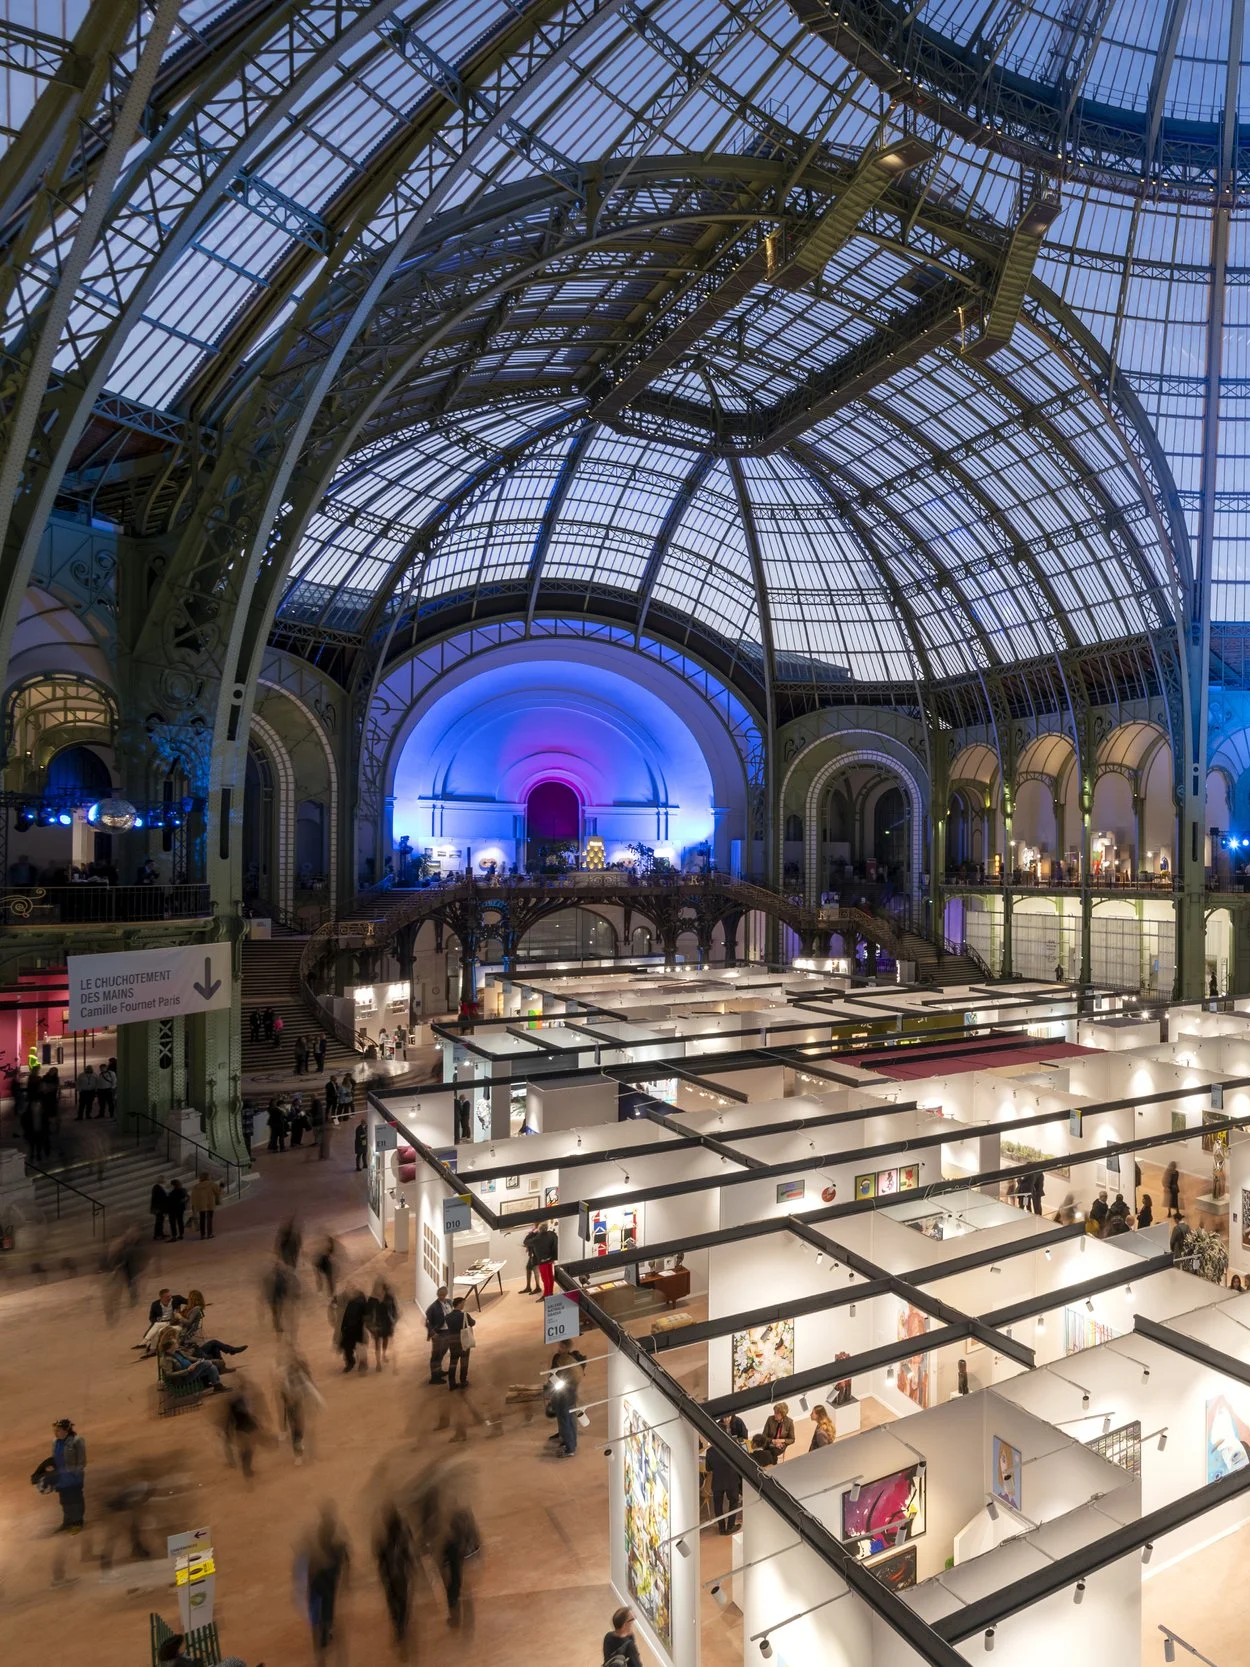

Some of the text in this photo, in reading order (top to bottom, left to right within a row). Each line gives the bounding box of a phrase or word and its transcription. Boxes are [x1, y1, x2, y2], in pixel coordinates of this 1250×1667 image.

[80, 969, 172, 991] LE CHUCHOTEMENT
[80, 987, 134, 1004] DES MAINS
[80, 994, 180, 1018] Camille Fournet Paris
[446, 1220, 460, 1230] D10
[547, 1324, 565, 1336] C10
